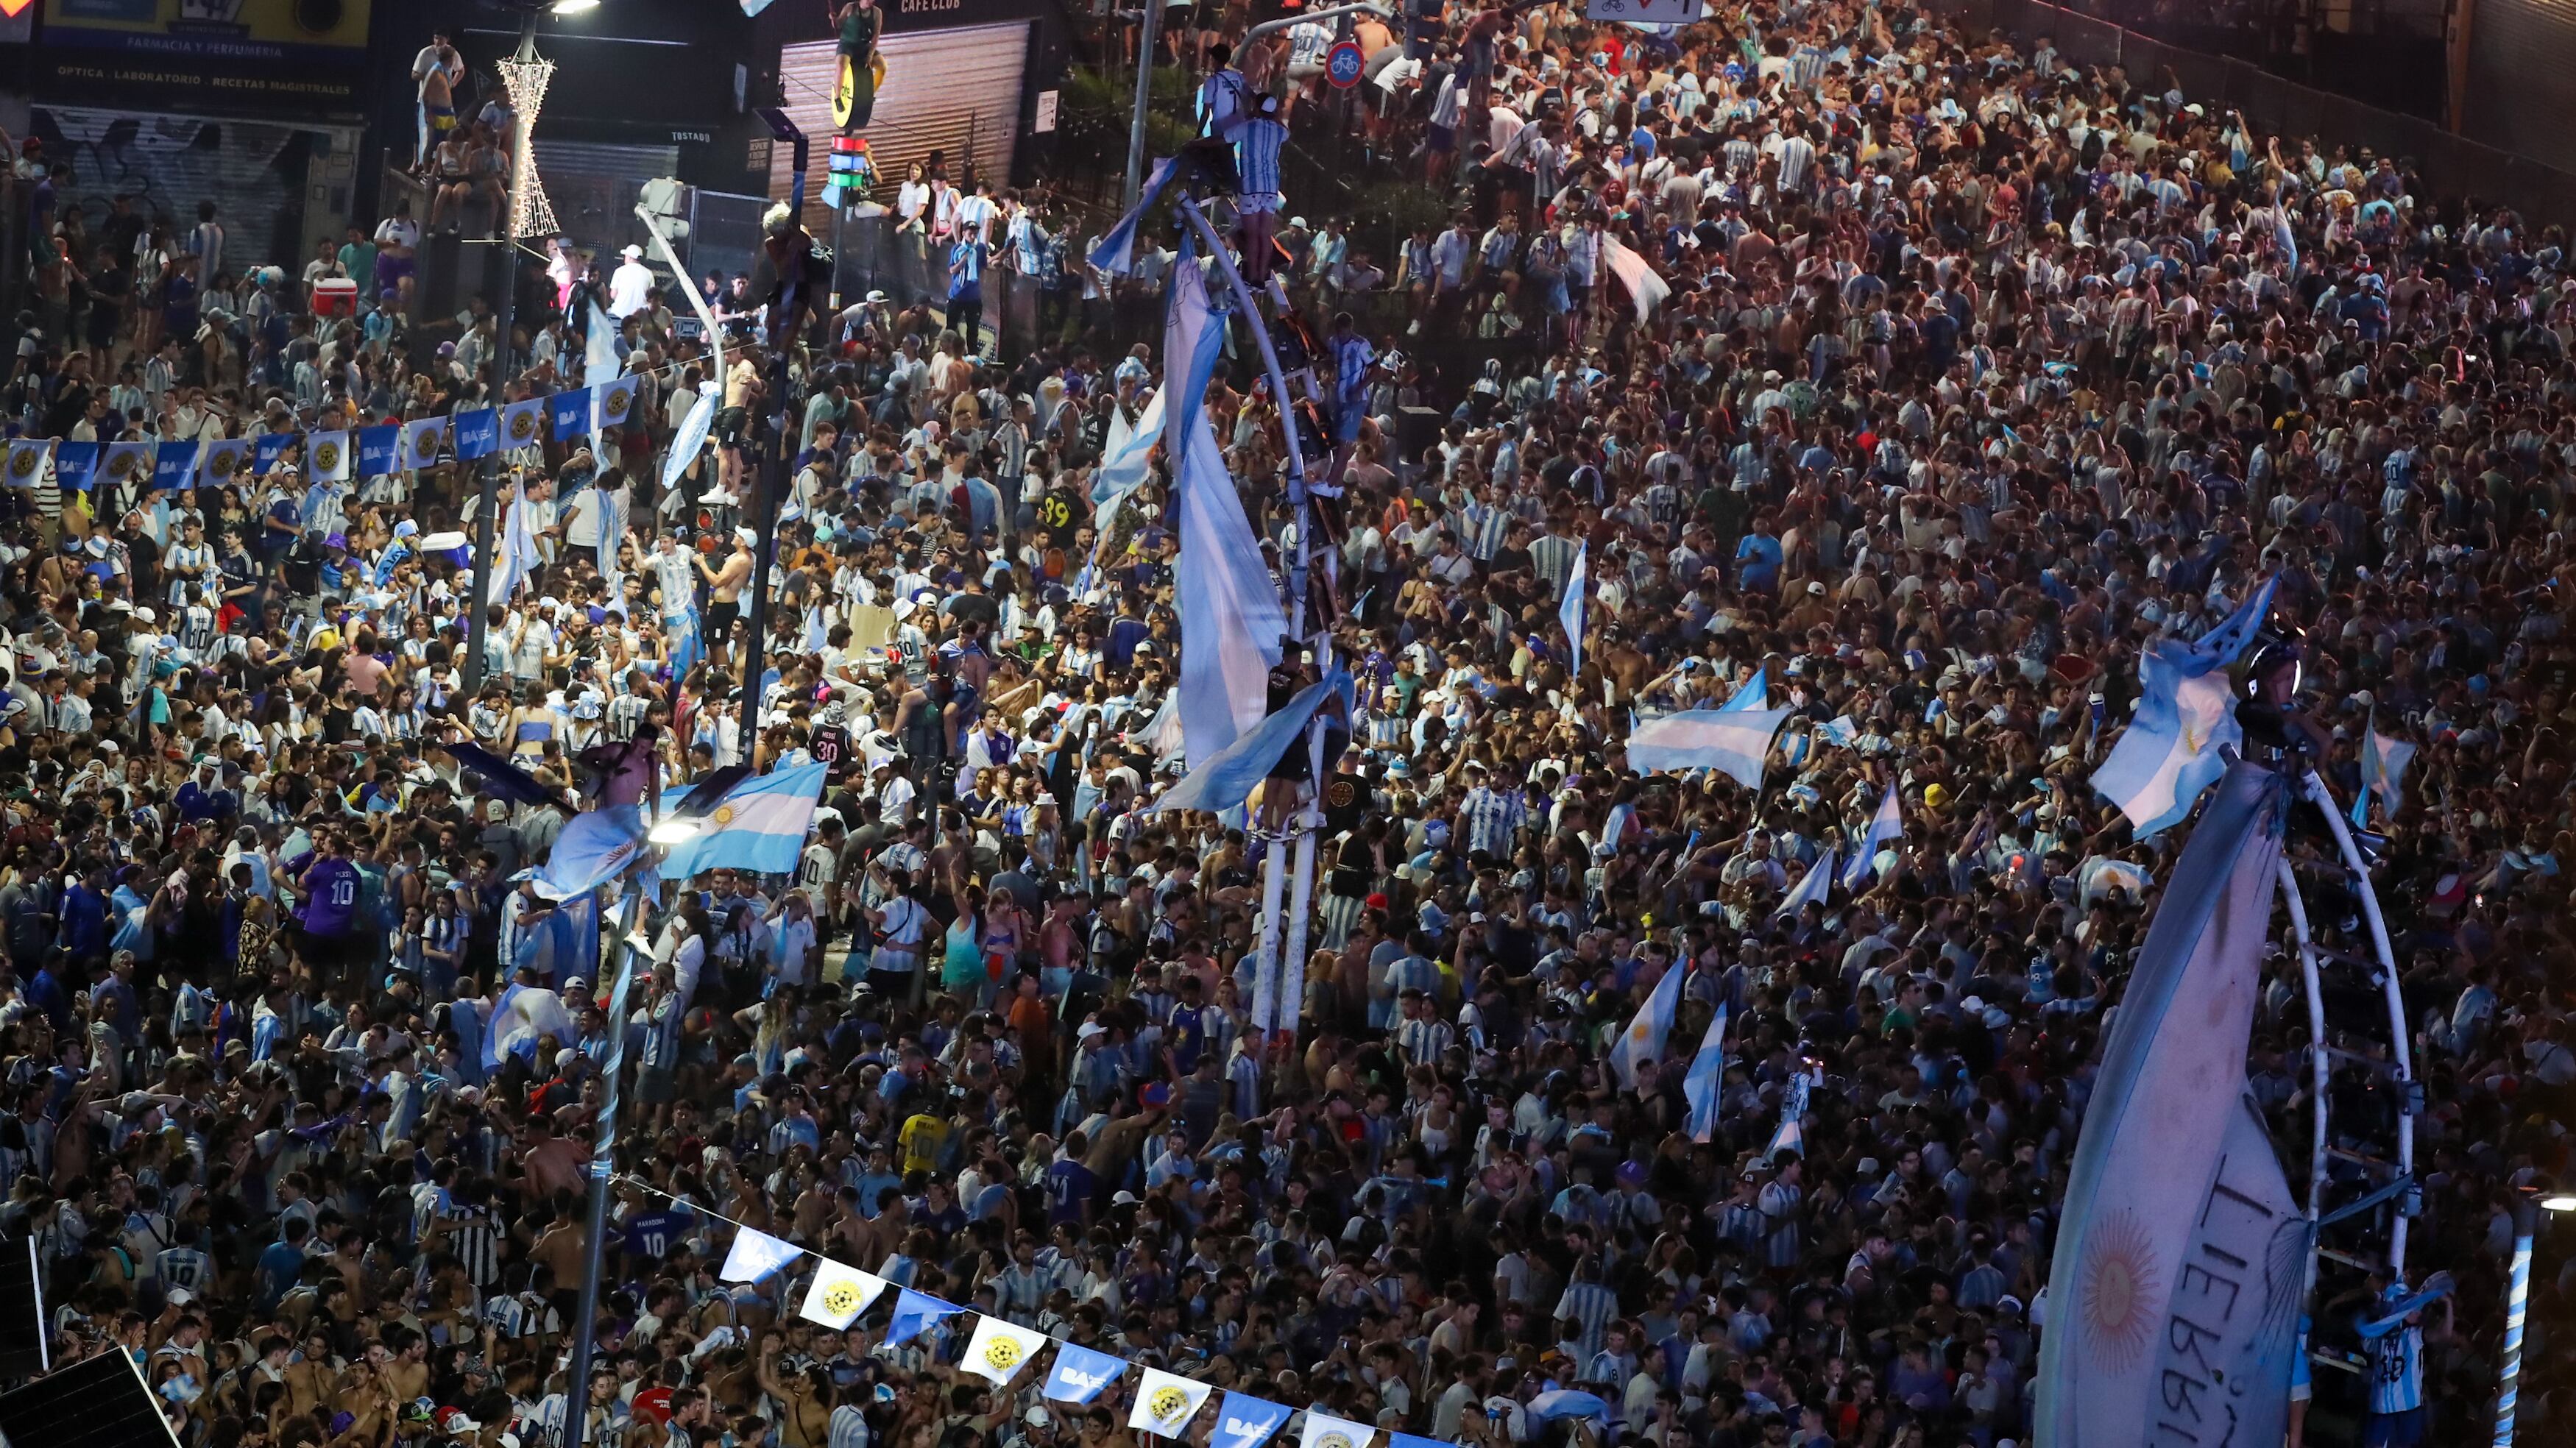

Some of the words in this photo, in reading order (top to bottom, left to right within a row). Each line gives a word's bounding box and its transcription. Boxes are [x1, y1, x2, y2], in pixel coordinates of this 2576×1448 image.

[901, 0, 929, 13] CAFE
[932, 0, 960, 10] CLUB
[127, 37, 191, 52] FARMACIA
[196, 42, 203, 52] Y
[207, 43, 283, 57] PERFUMERIA
[57, 66, 104, 78] OPTICA
[114, 71, 201, 85] LABORATORIO
[213, 77, 266, 89] RECETAS
[270, 82, 350, 95] MAGISTRALES
[671, 131, 710, 143] TOSTADO
[558, 410, 577, 425] BA
[461, 429, 479, 445] BA
[260, 447, 278, 460] BA
[363, 446, 382, 461] BA
[58, 460, 75, 473] BA
[158, 461, 177, 474] BA
[2386, 464, 2399, 481] 10
[1657, 503, 1674, 522] 10
[189, 628, 208, 650] 10
[899, 640, 913, 656] 10
[616, 715, 637, 743] 10
[821, 731, 837, 739] MESSI
[816, 740, 839, 763] 30
[335, 870, 352, 879] MESSI
[801, 856, 819, 886] 10
[330, 879, 354, 906] 10
[350, 1065, 369, 1079] FIL
[1482, 1093, 1493, 1106] 10
[637, 1218, 666, 1228] MARADONA
[642, 1232, 665, 1259] 10
[169, 1266, 197, 1286] 10
[490, 1310, 507, 1321] MESSI
[1059, 1366, 1090, 1388] BA
[1608, 1369, 1618, 1381] 18
[2380, 1355, 2405, 1383] 10
[1225, 1417, 1256, 1438] BA
[547, 1424, 563, 1448] 10
[599, 1430, 610, 1444] 10
